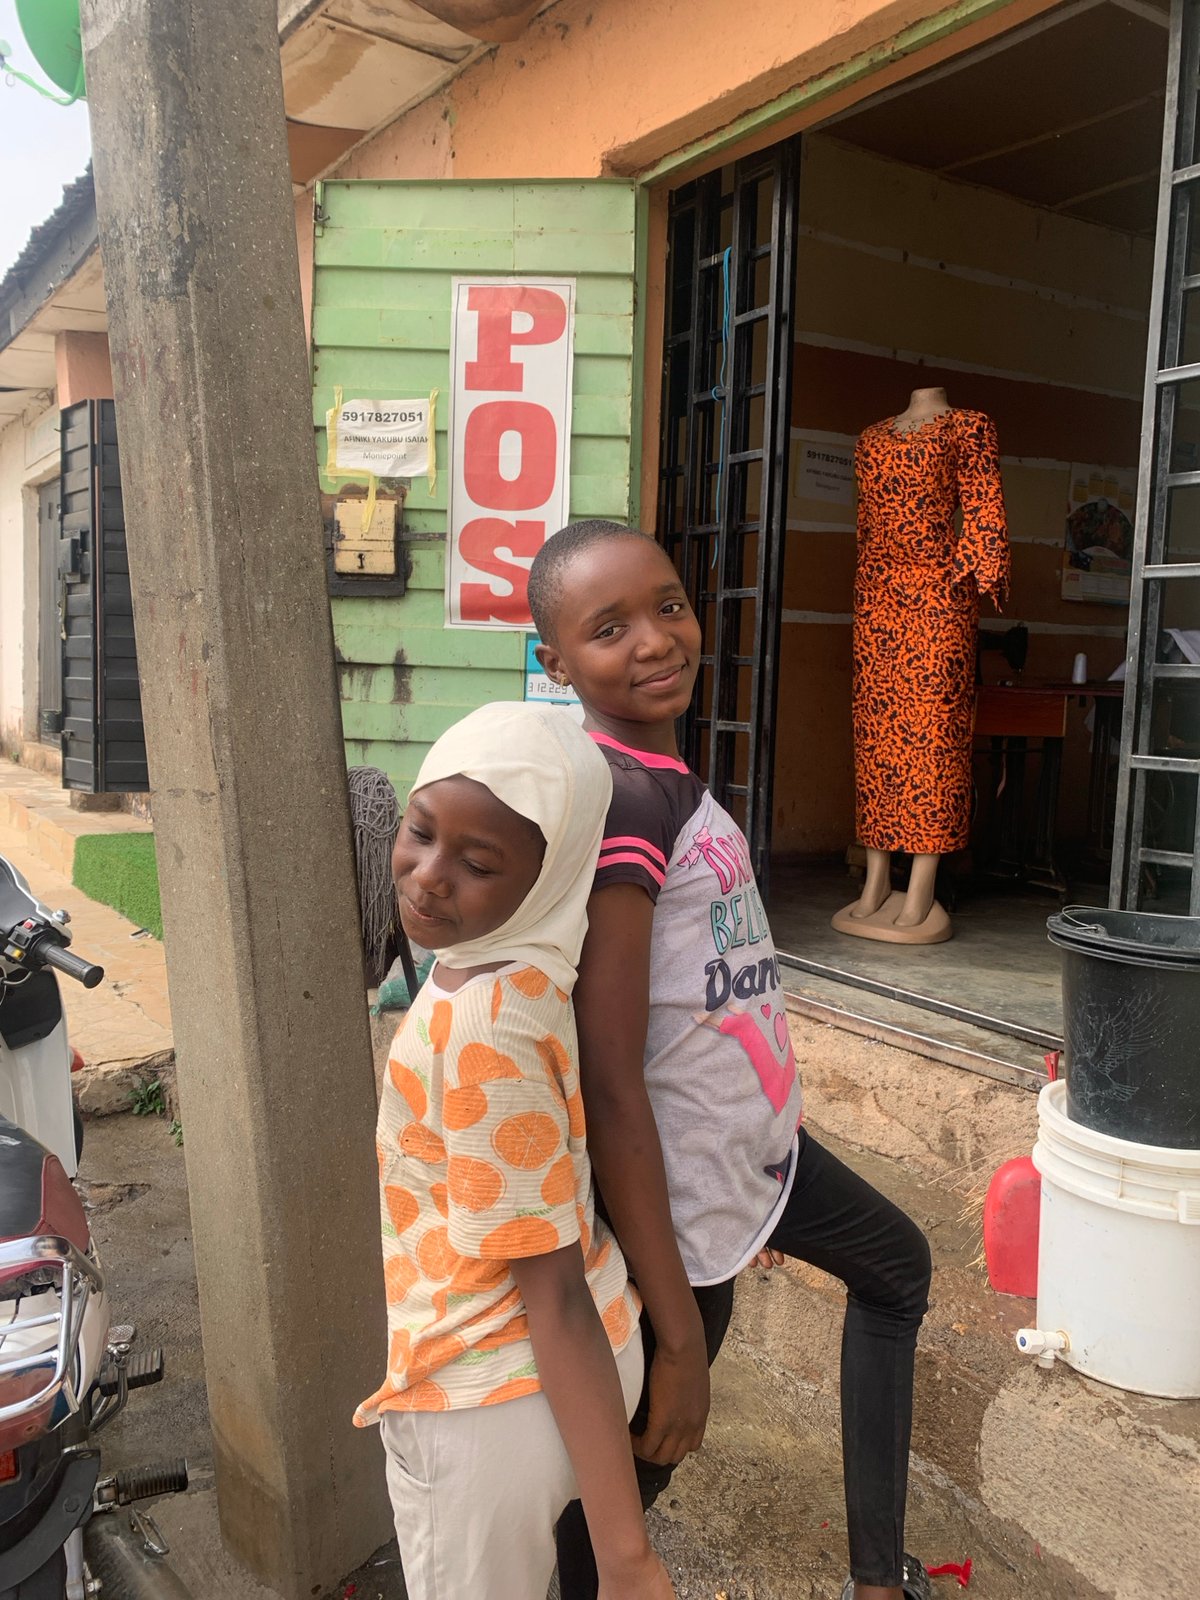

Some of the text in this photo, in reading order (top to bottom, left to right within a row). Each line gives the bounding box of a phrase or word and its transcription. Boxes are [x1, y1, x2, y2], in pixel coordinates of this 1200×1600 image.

[342, 411, 423, 422] 5917827051
[363, 452, 407, 460] Moniepoint
[458, 286, 567, 624] POS
